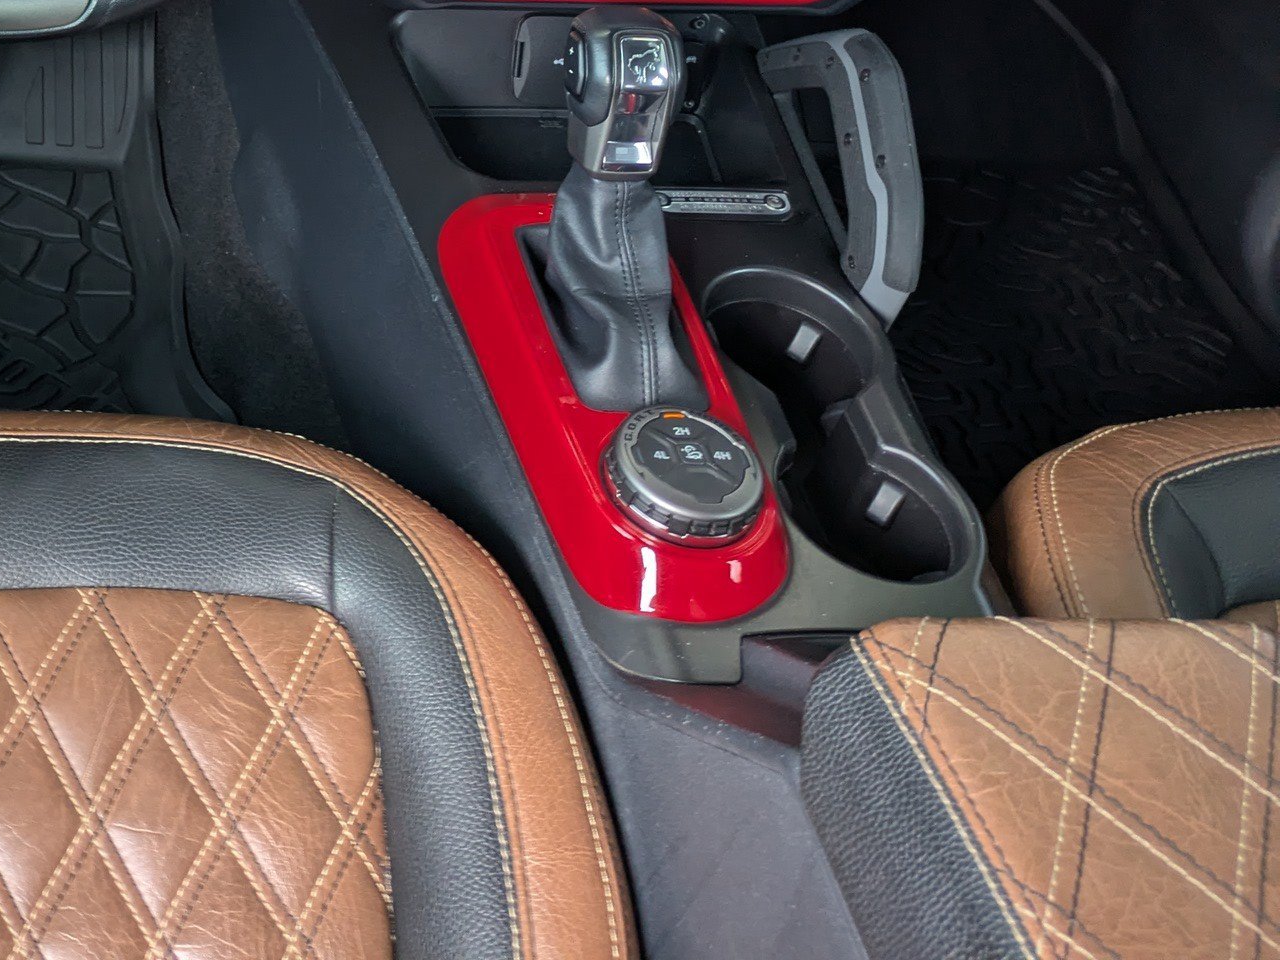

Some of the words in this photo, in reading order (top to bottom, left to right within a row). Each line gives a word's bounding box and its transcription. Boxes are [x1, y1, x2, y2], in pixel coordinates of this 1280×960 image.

[672, 426, 691, 436] 2H
[653, 450, 670, 460] 4L
[713, 451, 733, 460] 4H
